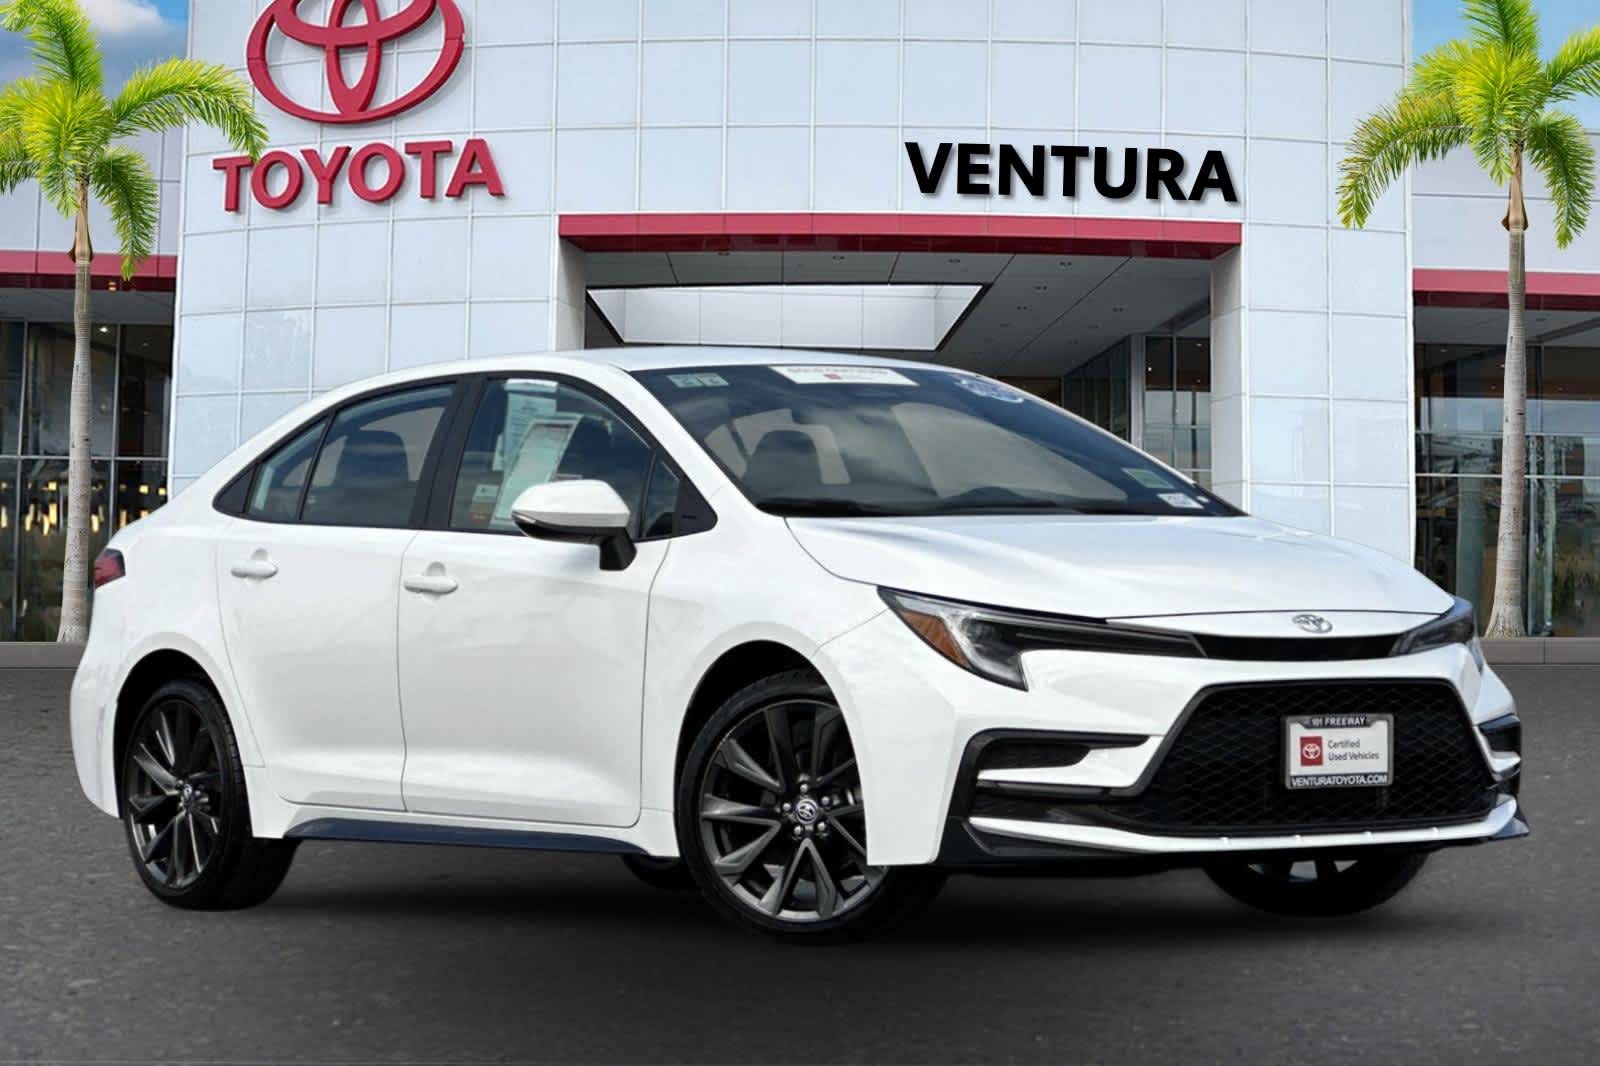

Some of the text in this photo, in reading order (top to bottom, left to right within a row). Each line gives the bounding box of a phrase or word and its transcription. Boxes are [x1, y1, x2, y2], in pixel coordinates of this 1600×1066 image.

[212, 138, 505, 212] TOYOTA
[904, 141, 1239, 203] VENTURA
[1324, 716, 1366, 726] FREEWAY
[1328, 738, 1360, 749] Certified
[1328, 751, 1380, 761] Used Vehicles
[1291, 775, 1388, 787] VENTURATOYOTA.COM
